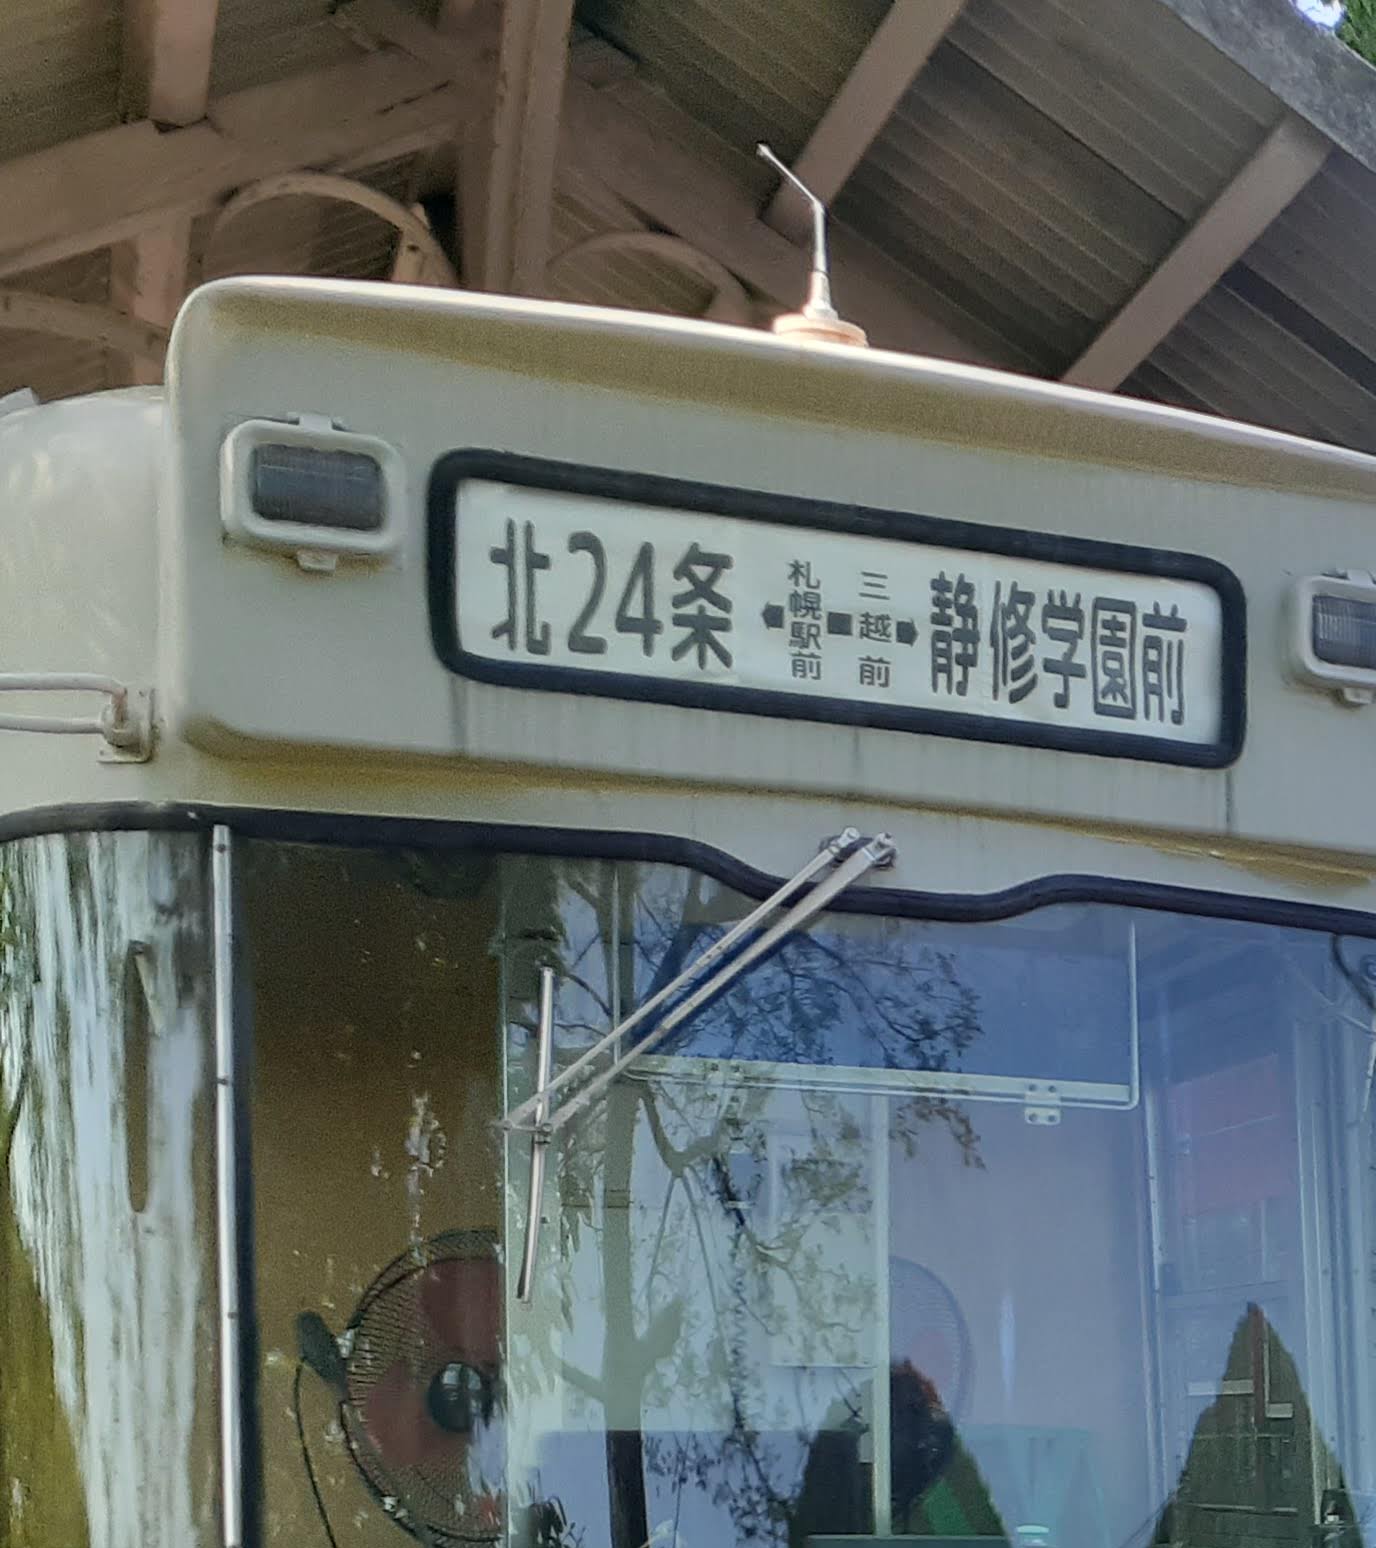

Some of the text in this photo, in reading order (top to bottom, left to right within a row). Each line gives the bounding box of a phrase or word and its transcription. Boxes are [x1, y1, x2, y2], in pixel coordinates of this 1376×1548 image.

[490, 517, 734, 669] 北24条
[787, 559, 823, 681] 札幌駅前
[858, 571, 893, 688] 三越前
[930, 571, 1188, 726] 静修学園前
